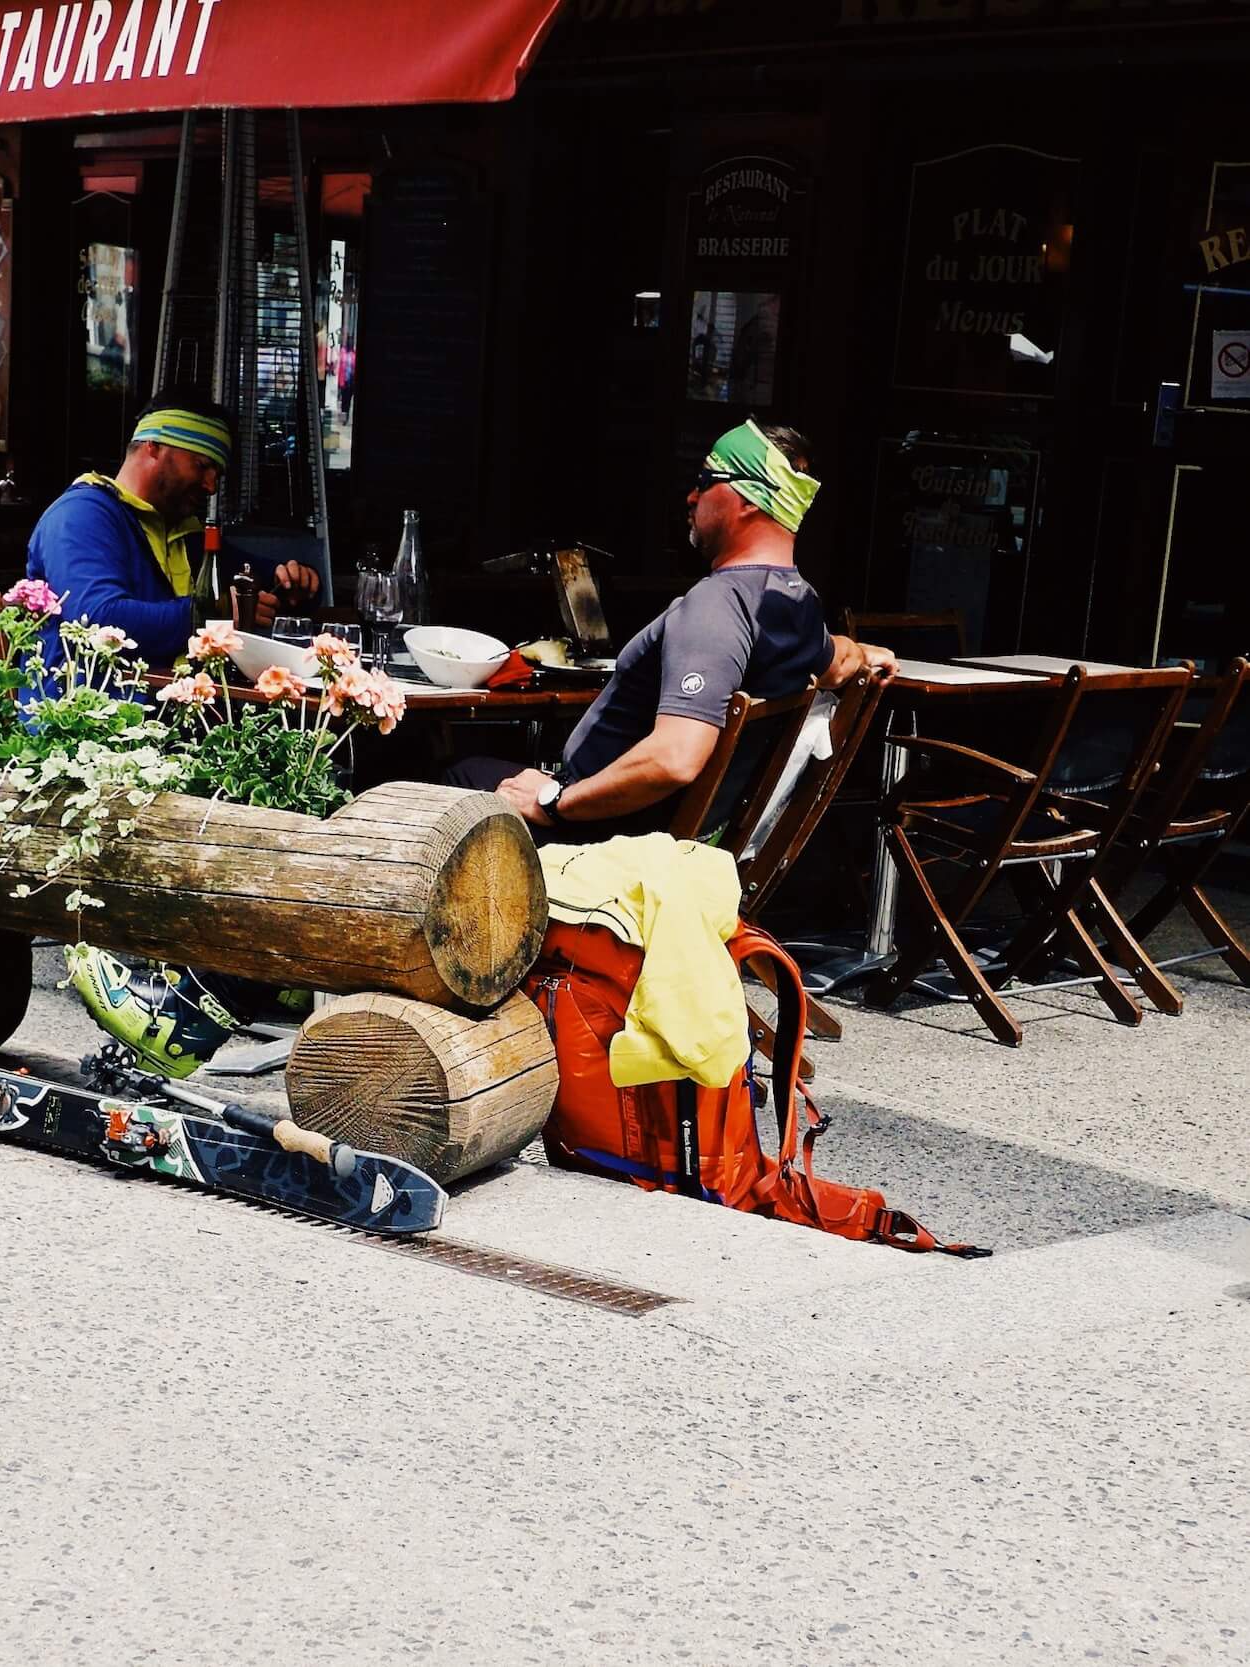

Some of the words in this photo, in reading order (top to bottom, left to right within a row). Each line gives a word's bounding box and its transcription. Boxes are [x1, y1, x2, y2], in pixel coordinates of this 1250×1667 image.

[704, 169, 791, 206] RESTAURANT
[951, 207, 1030, 244] PLAT
[697, 237, 791, 257] BRASSERIE
[1199, 228, 1250, 274] RE
[925, 252, 959, 282] du
[969, 255, 1043, 283] JOUR
[934, 300, 1026, 336] Menus
